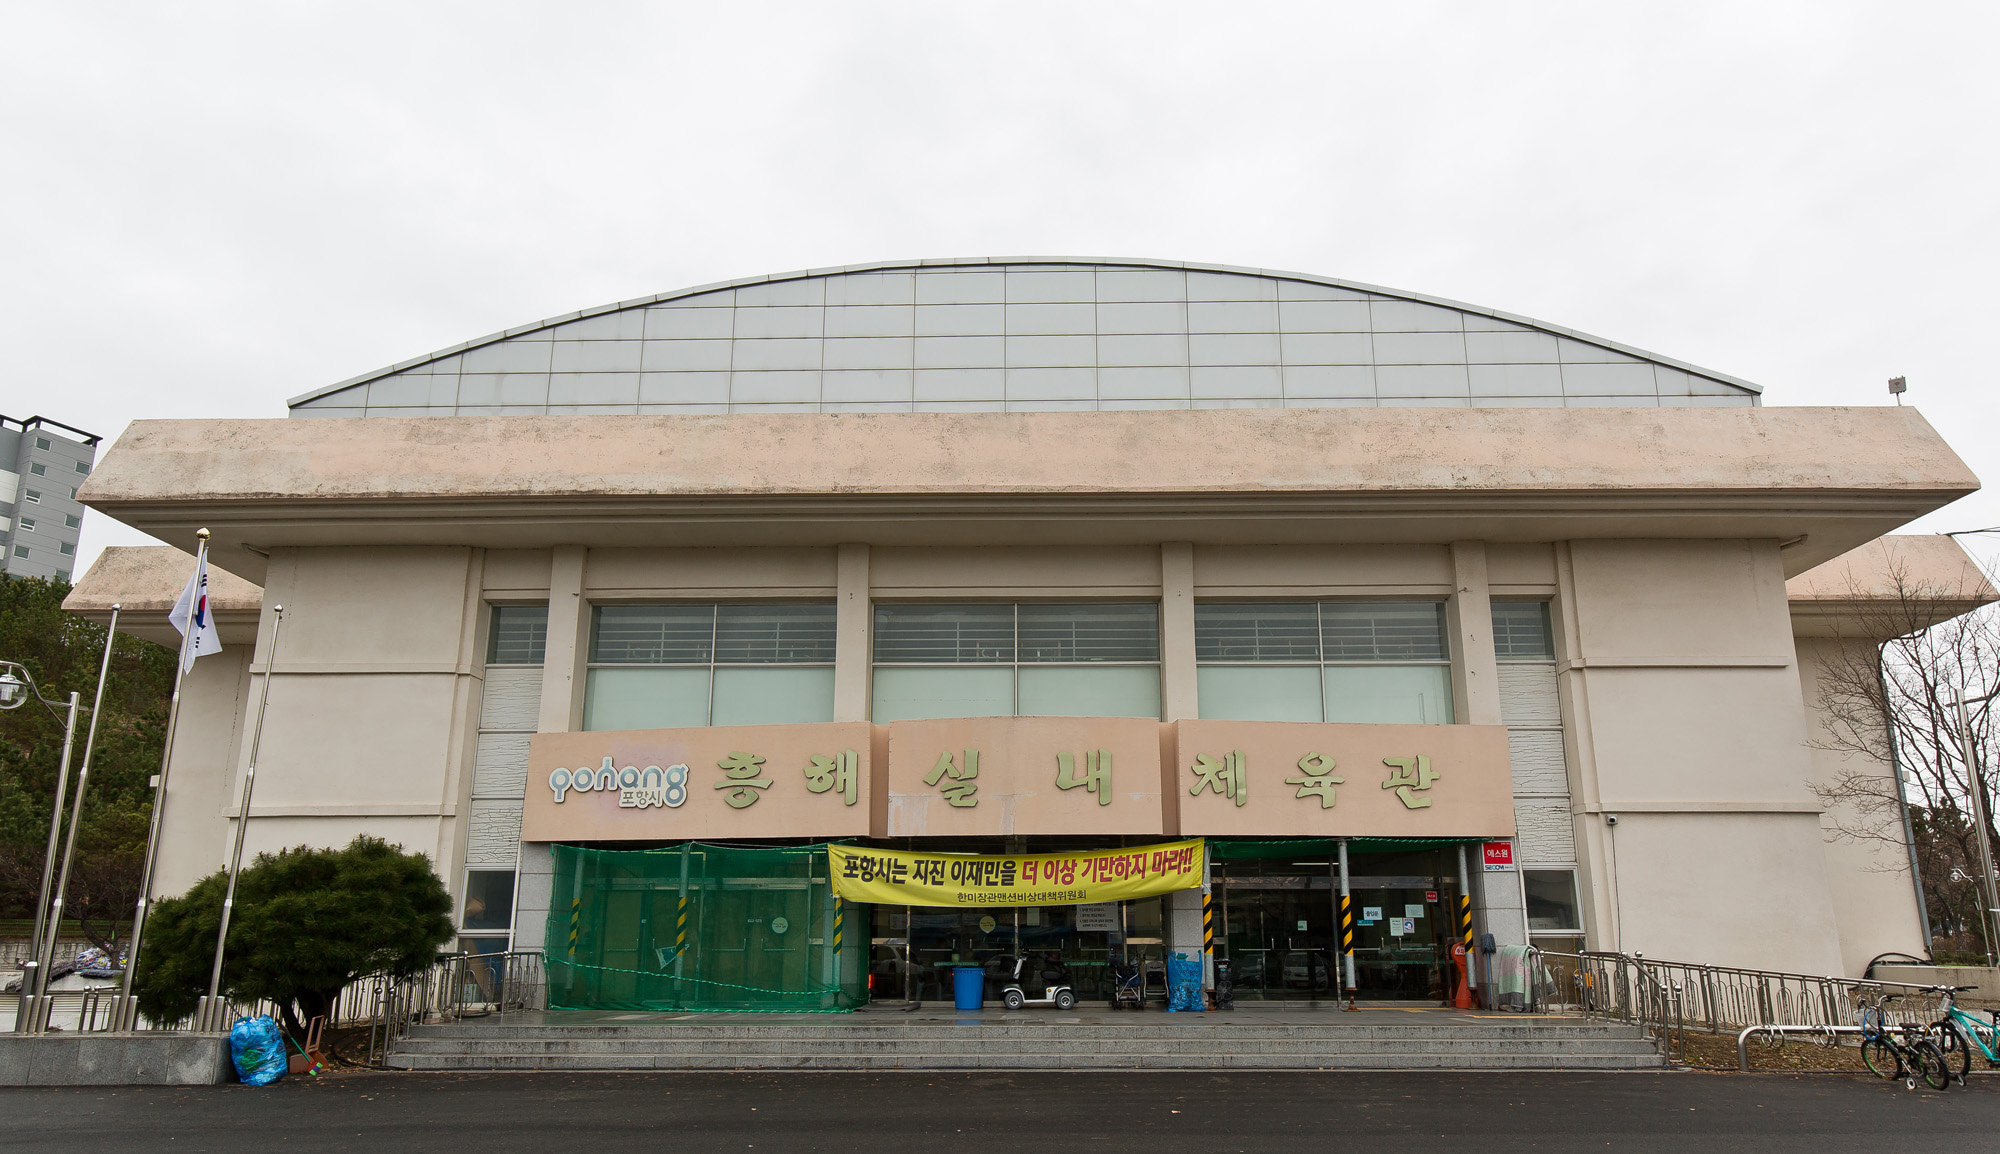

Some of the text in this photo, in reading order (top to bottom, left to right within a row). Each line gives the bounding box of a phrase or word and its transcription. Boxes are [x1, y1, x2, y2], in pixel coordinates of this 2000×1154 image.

[714, 748, 1441, 809] 흥해 실내 체육관
[621, 790, 661, 806] 포항시
[843, 847, 1193, 887] 포항시는 지진 이재민을 더 이상 기만하지 마라!!
[1486, 848, 1509, 858] 에스원
